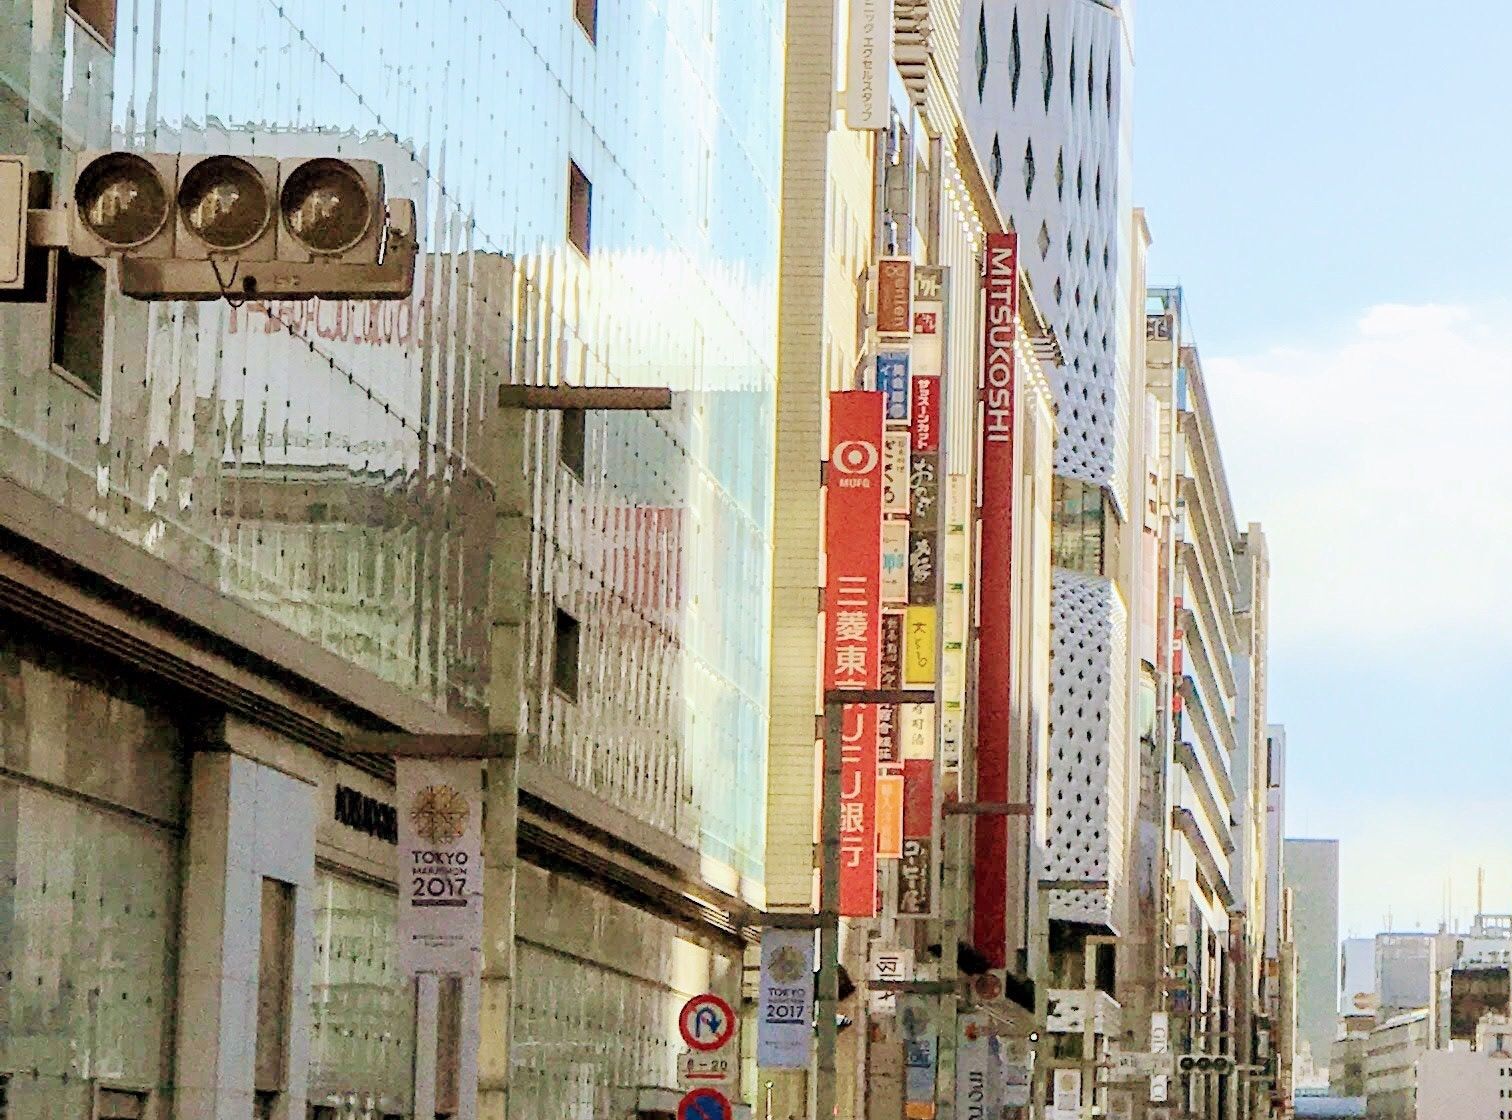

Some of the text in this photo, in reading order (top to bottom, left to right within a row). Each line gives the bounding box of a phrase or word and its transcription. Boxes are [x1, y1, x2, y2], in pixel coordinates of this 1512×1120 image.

[987, 248, 1013, 442] MITSUKOSHI
[839, 478, 870, 488] MUFG
[412, 851, 468, 864] TOKYO
[413, 877, 466, 896] 2017
[767, 1005, 804, 1017] 2017
